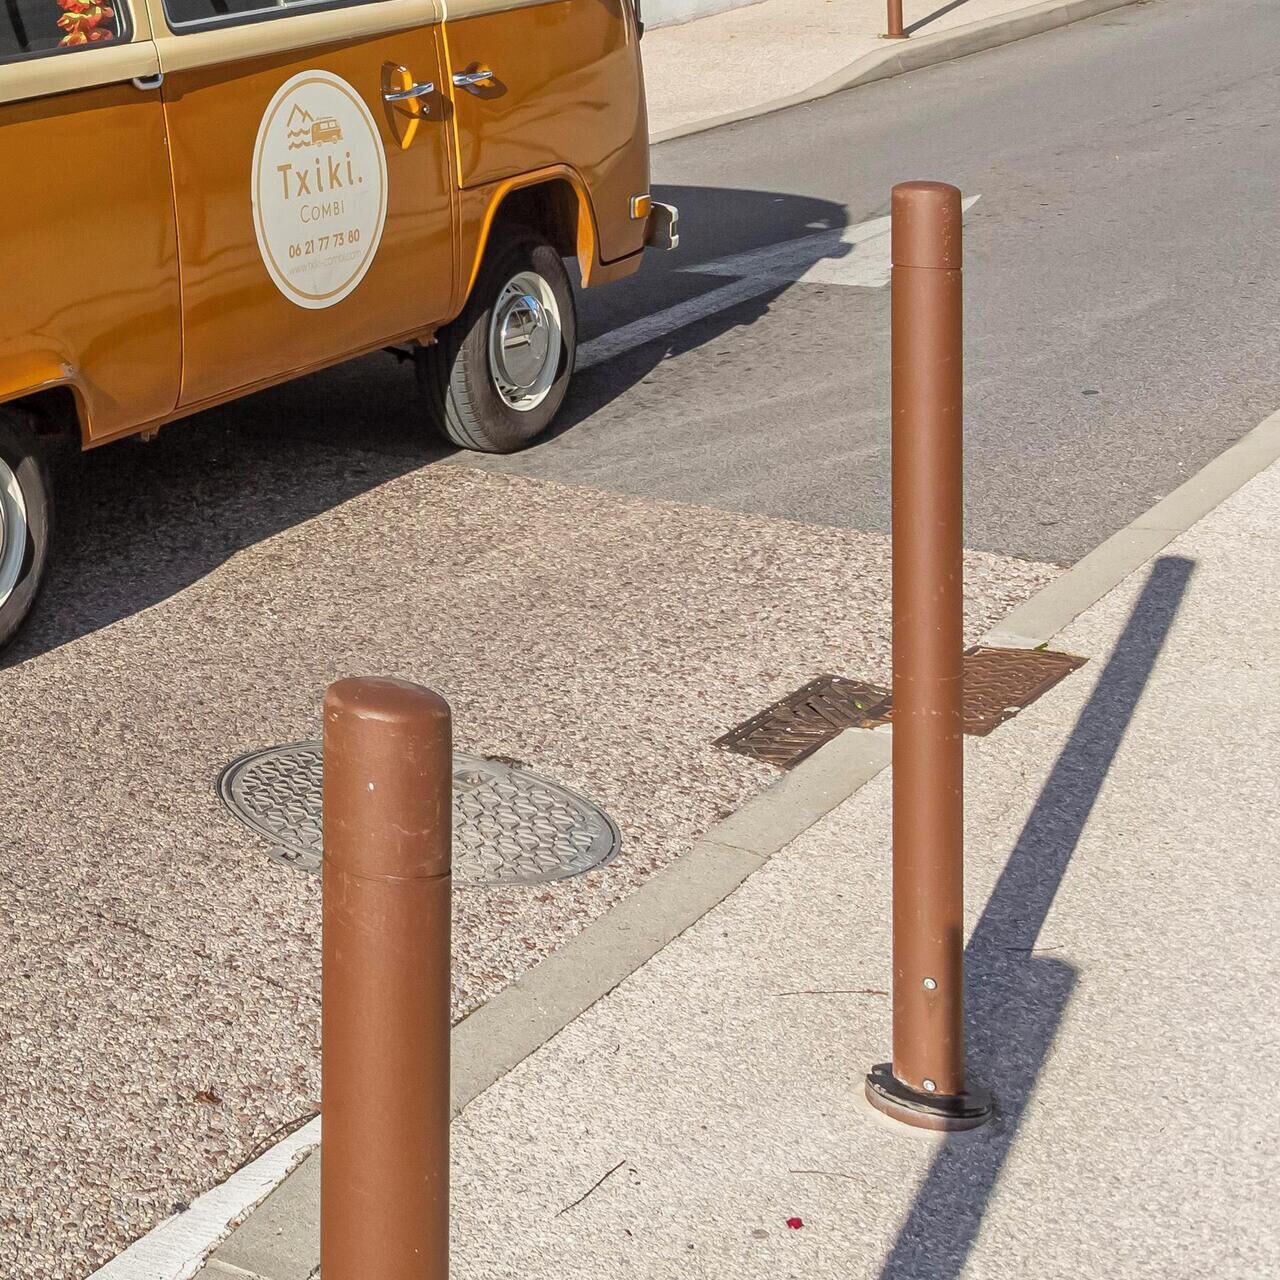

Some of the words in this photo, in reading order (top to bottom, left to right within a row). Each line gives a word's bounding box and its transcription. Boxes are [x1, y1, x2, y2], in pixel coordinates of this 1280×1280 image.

[277, 151, 363, 200] Txiki.
[289, 243, 302, 258] 06
[305, 239, 315, 255] 21
[318, 235, 330, 251] 77
[333, 232, 344, 247] 73
[348, 228, 360, 243] 80
